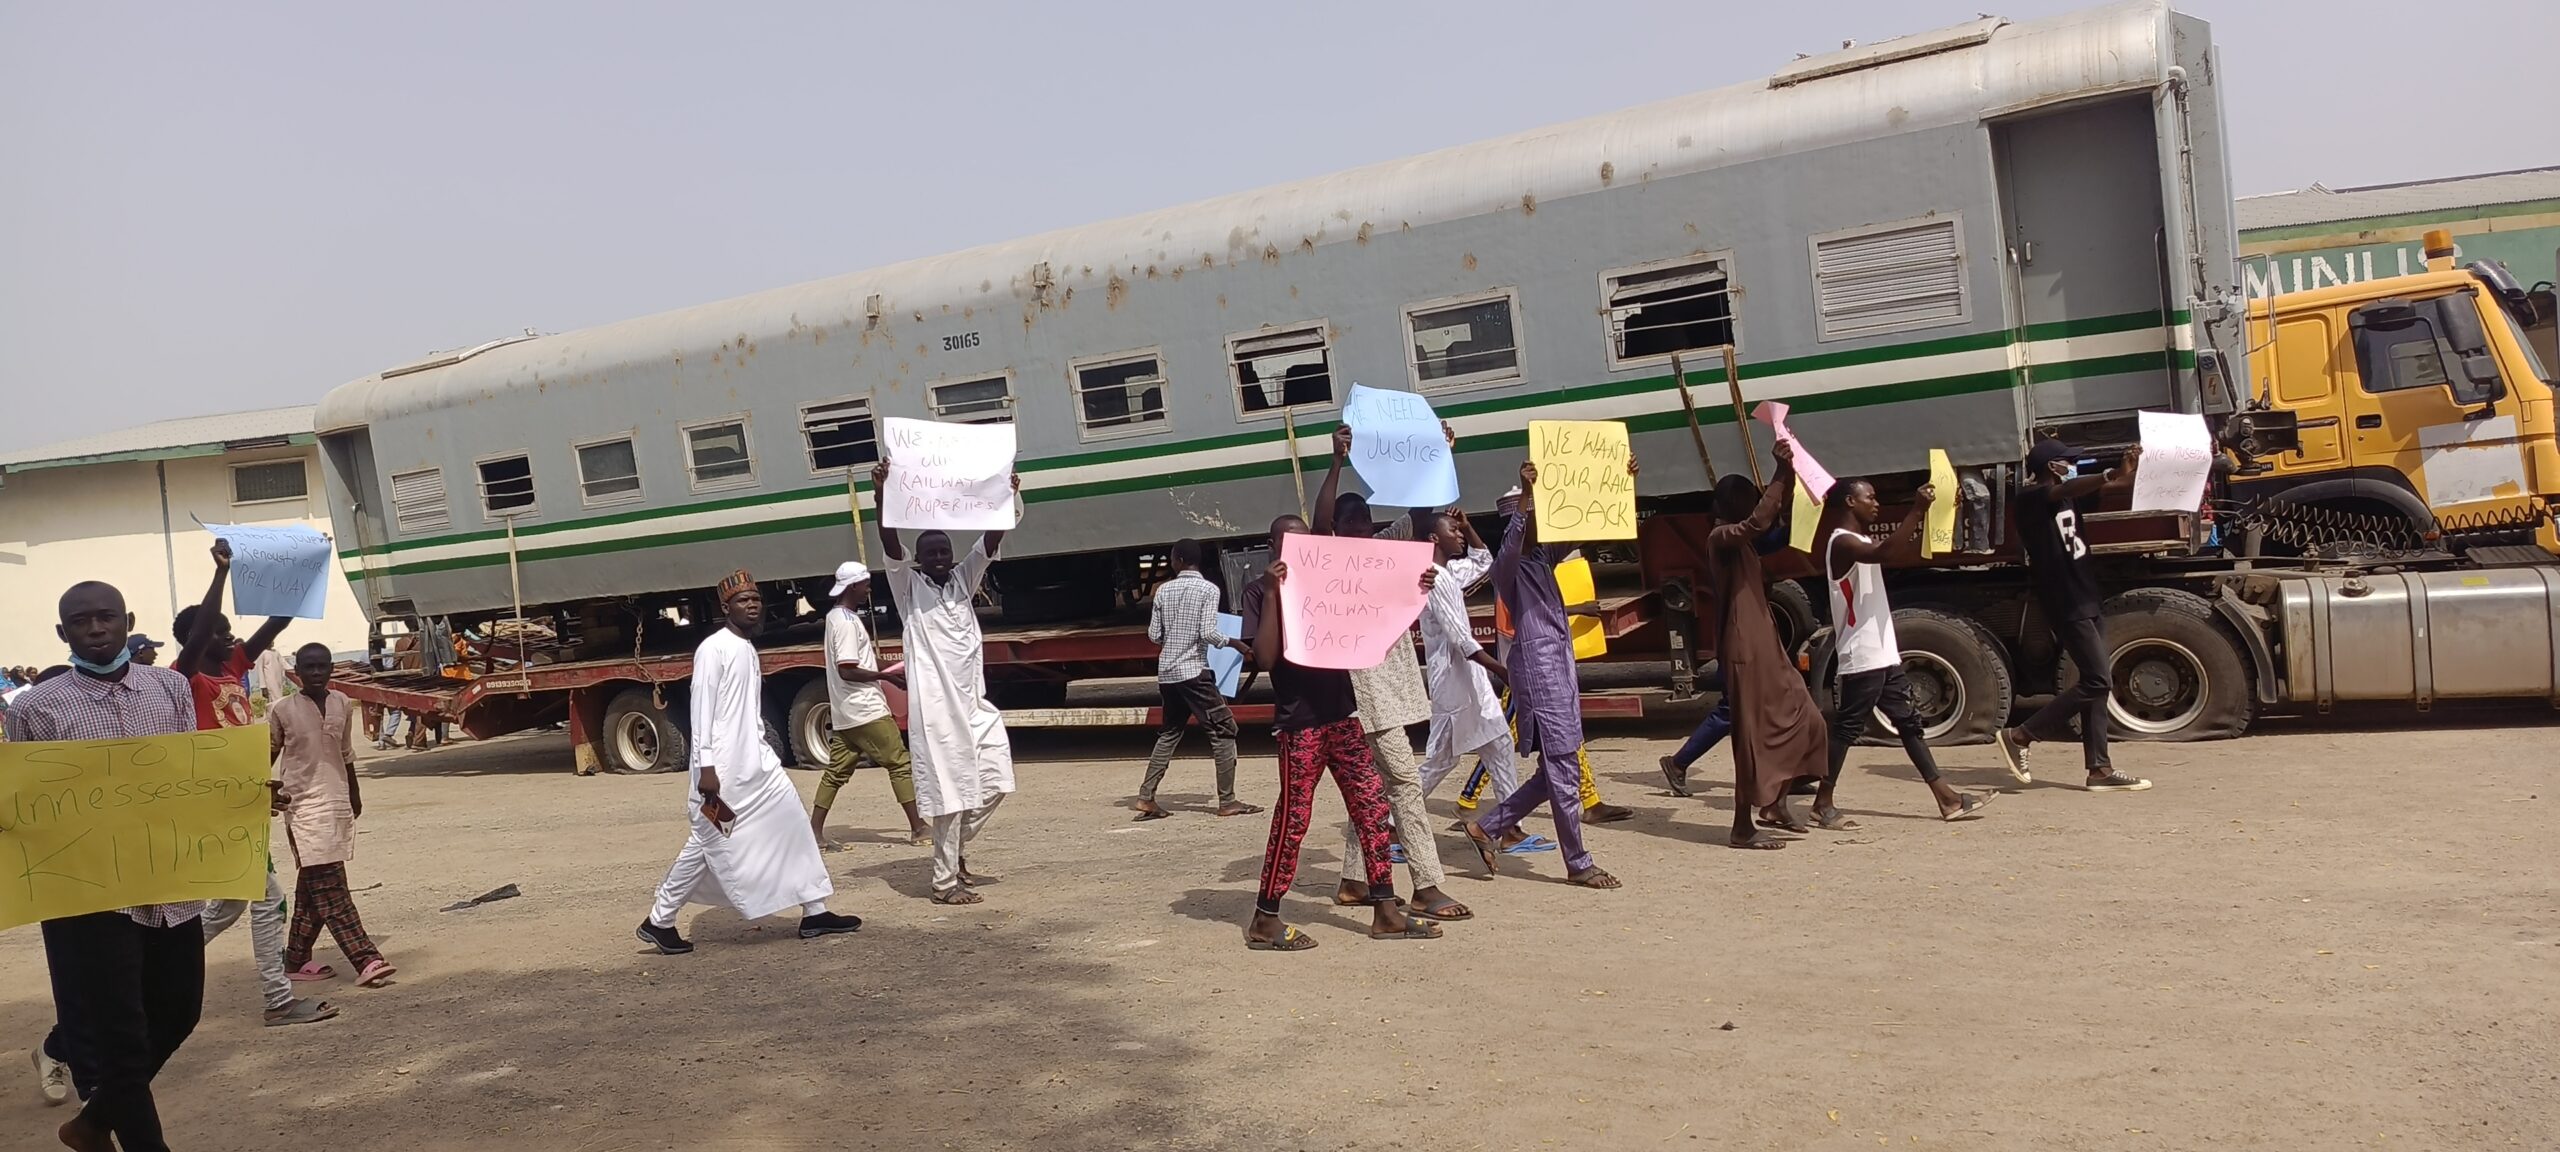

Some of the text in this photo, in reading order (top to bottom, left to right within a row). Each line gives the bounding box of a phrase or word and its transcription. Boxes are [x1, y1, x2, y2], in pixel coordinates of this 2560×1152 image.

[942, 331, 980, 351] 30165
[1375, 397, 1429, 423] NEED
[892, 427, 922, 449] WE
[1367, 430, 1440, 463] JUSTICE
[1539, 425, 1629, 466] WE WANT
[1541, 462, 1634, 495] OUR RAIL
[1545, 488, 1629, 530] BACK
[1298, 546, 1396, 573] WE NEED
[1325, 577, 1369, 595] OUR
[1301, 595, 1385, 619] RAILWAY
[1304, 624, 1367, 654] BACK
[23, 733, 229, 783] STOP
